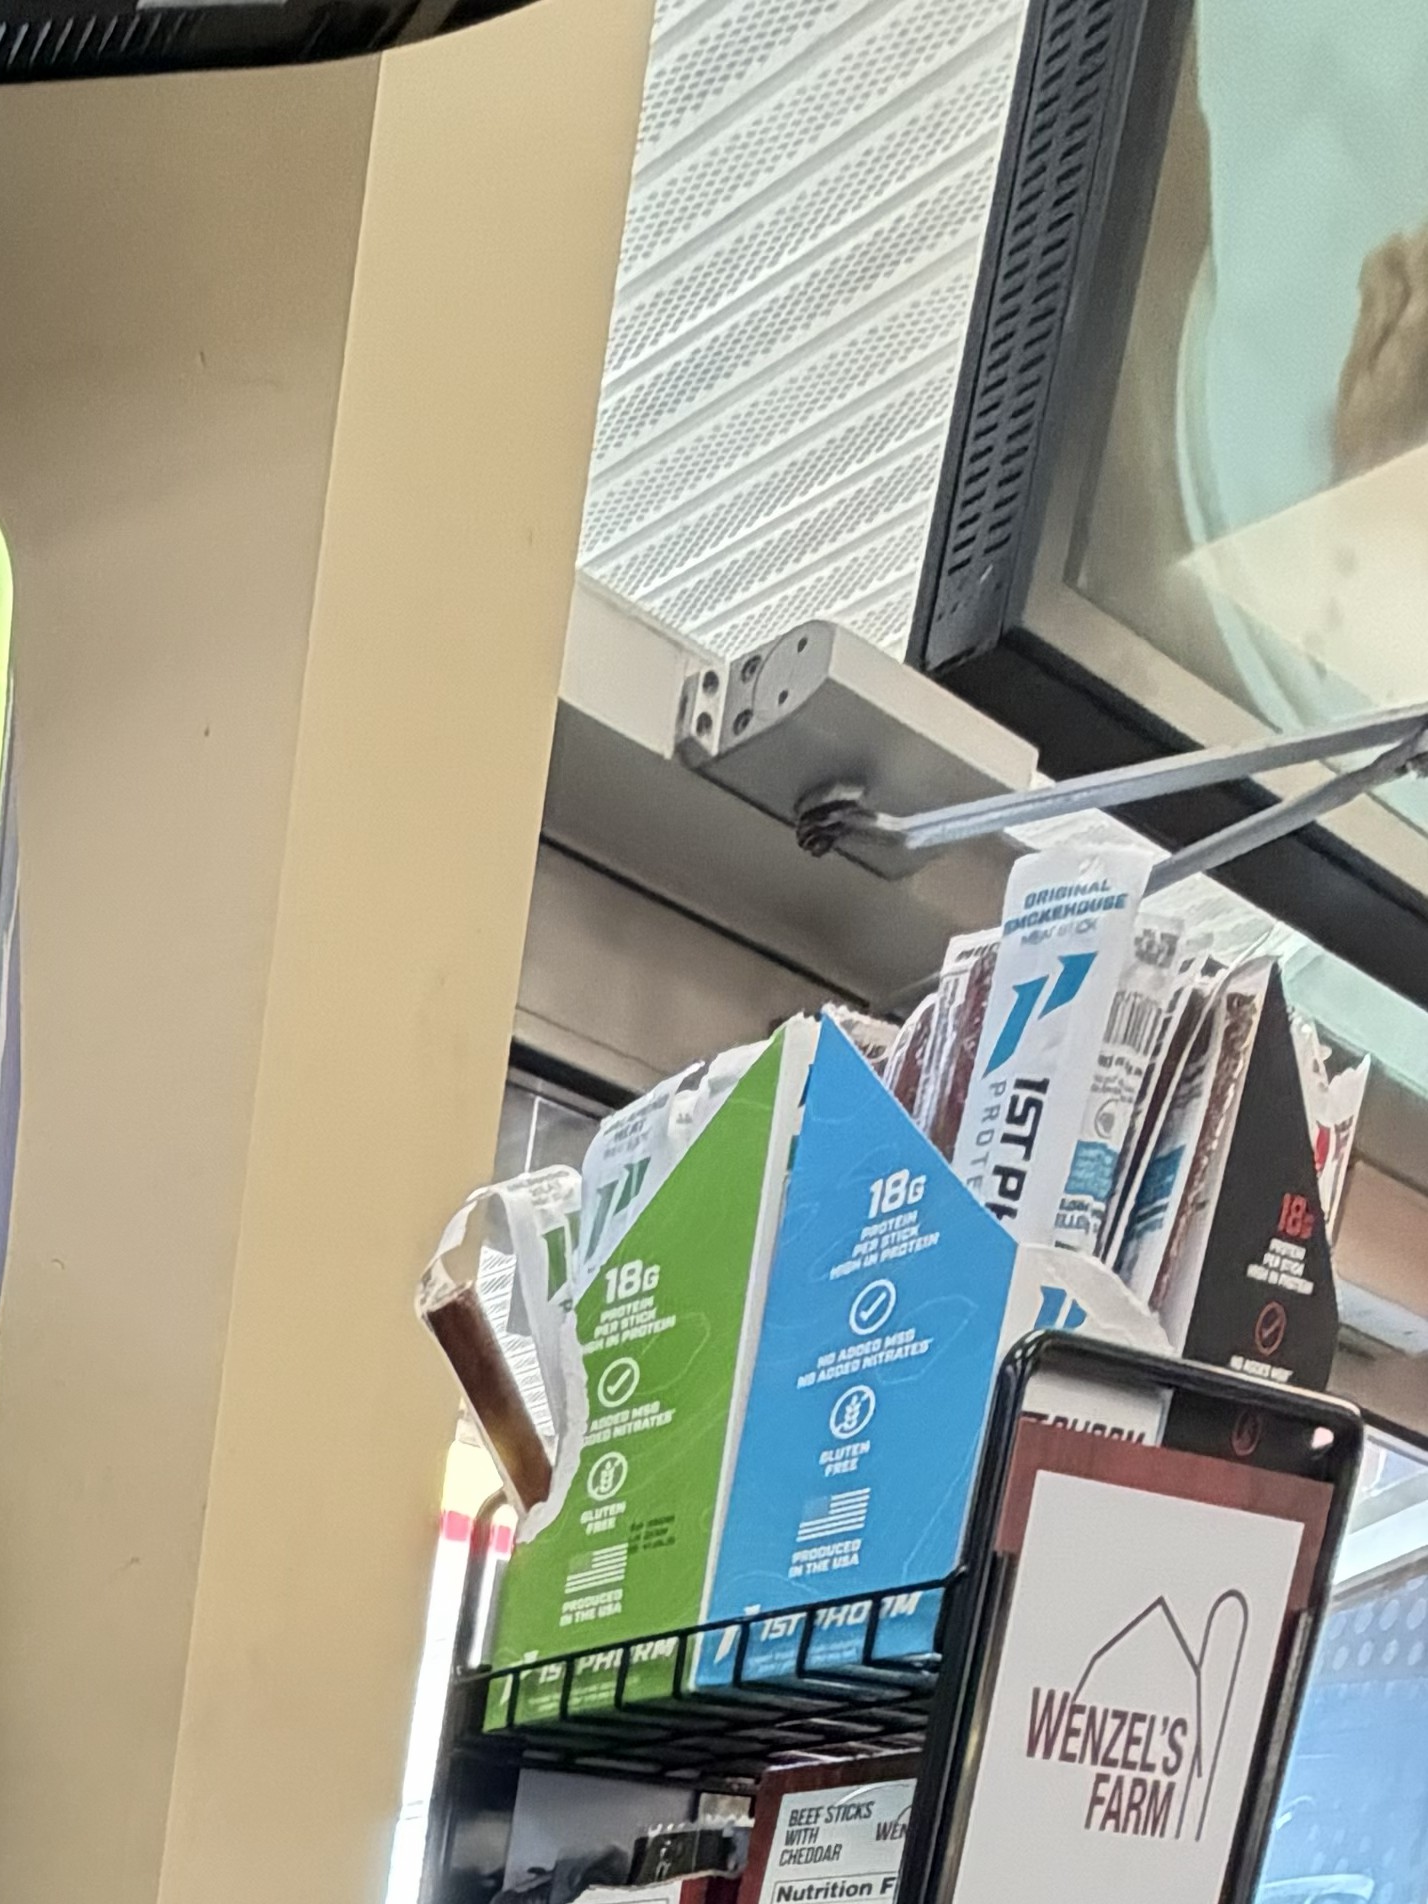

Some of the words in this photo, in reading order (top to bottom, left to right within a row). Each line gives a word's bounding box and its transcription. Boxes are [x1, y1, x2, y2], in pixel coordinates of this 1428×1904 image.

[1027, 1687, 1188, 1776] WENZEL'S
[789, 1807, 821, 1826] BEEF
[824, 1802, 874, 1824] STICKS
[1085, 1773, 1176, 1839] FARM
[779, 1845, 842, 1866] CHEDDAR
[776, 1883, 873, 1903] Nutrition
